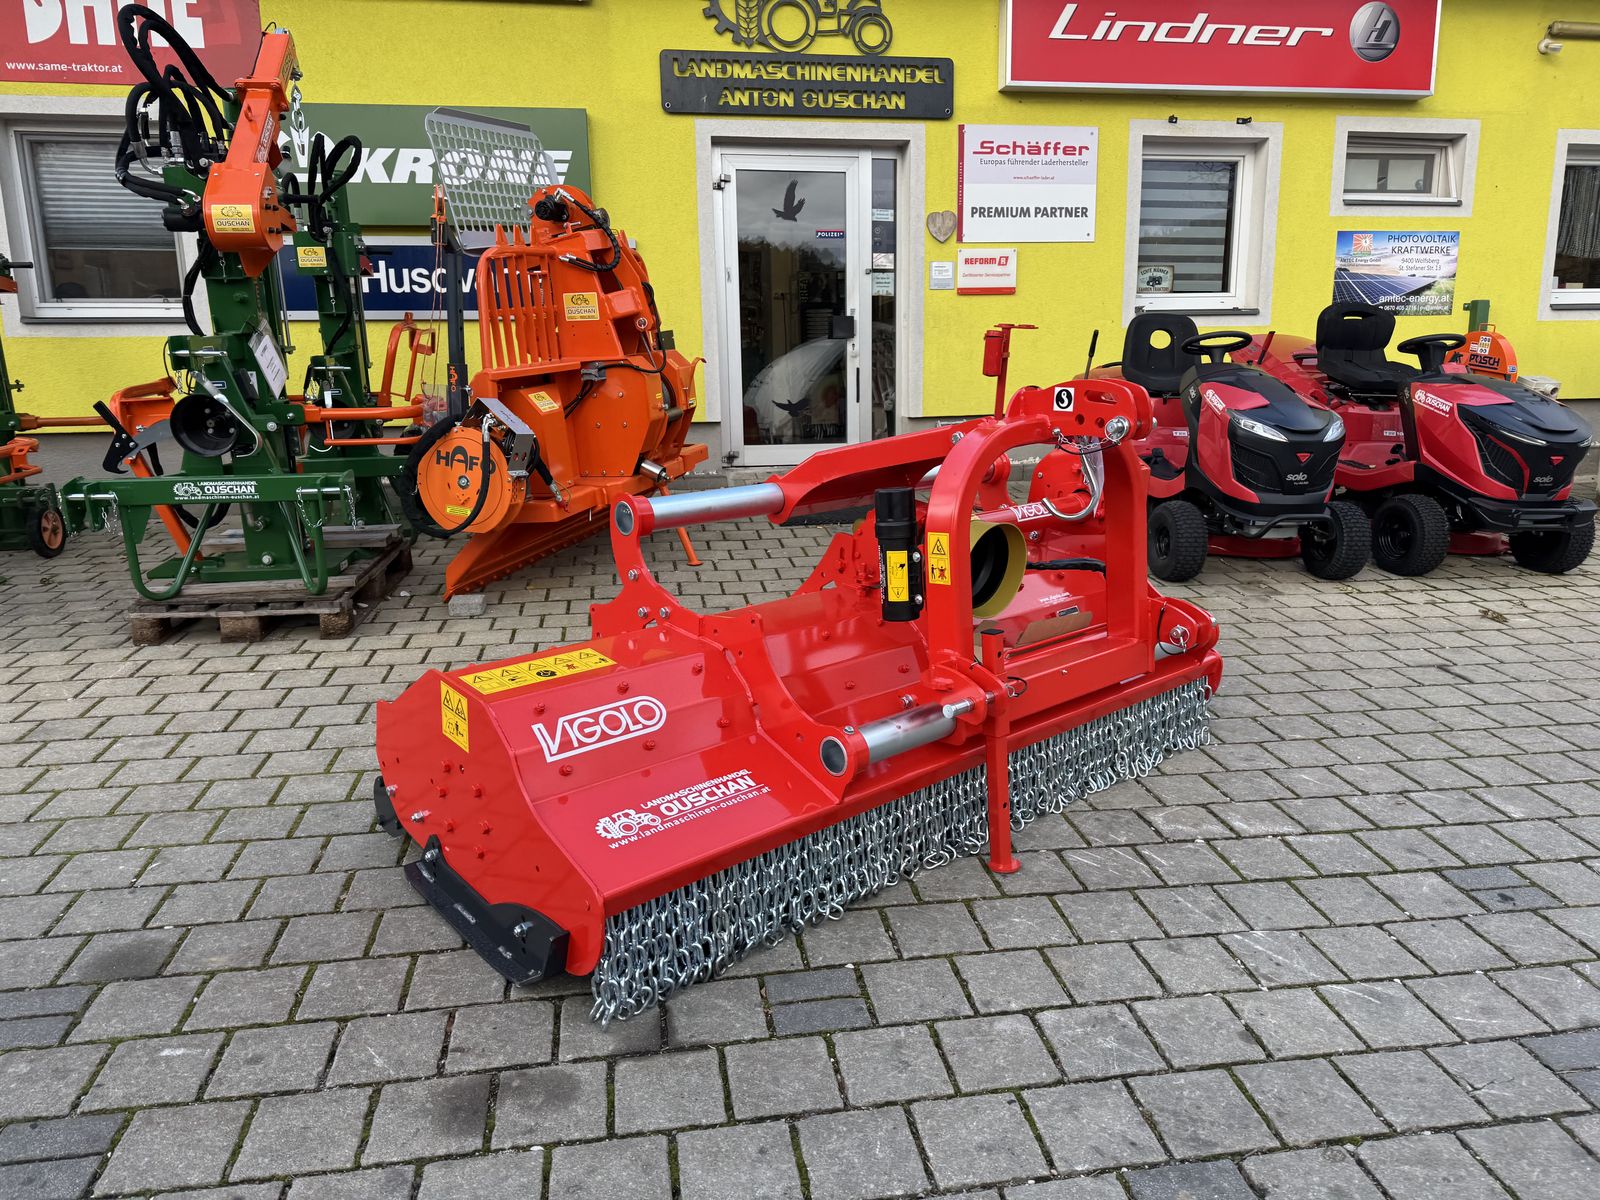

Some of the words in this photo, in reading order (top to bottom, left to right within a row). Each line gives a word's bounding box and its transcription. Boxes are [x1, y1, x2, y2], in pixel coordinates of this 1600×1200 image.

[1048, 2, 1334, 47] Lindner
[6, 61, 123, 73] www.same-traktor.at
[672, 57, 944, 84] LANDMASCHINENHANDEL
[718, 86, 795, 108] ANTON
[801, 89, 906, 110] OUSCHAN
[973, 140, 1090, 156] Schäffer
[980, 158, 1006, 167] Europas
[1007, 158, 1040, 166] führender
[1041, 159, 1089, 167] Laderhersteller
[970, 206, 1031, 218] PREMIUM
[1034, 206, 1089, 218] PARTNER
[1388, 234, 1457, 243] PHOTOVOLTAIK
[1391, 245, 1451, 255] KRAFTWERKE
[965, 257, 997, 265] REFORM
[1379, 294, 1450, 305] amtec-energy.at
[1286, 472, 1308, 481] solo
[204, 485, 255, 494] OUSCHAN
[532, 696, 667, 763] VIGOLO
[640, 768, 752, 810] LANDMASCHINENHANDEL
[659, 775, 757, 817] OUSCHAN
[608, 786, 771, 850] www.landmaschinen-ouschan.at
